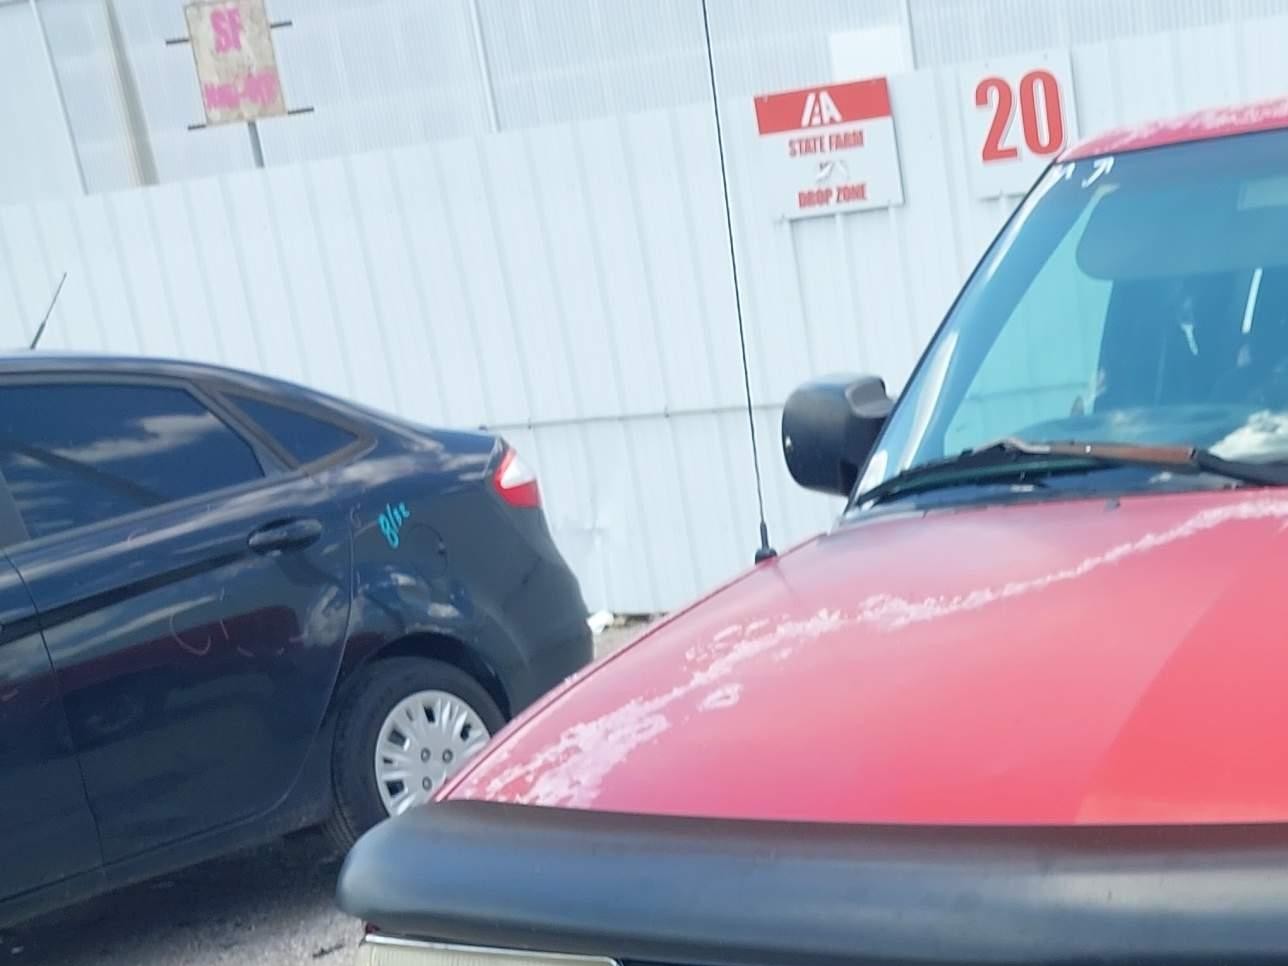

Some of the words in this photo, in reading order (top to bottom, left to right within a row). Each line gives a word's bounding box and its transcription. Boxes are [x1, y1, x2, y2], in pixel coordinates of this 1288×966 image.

[974, 68, 1065, 163] 20
[788, 134, 826, 157] STATE
[828, 129, 864, 152] FARM
[798, 187, 833, 208] DROP
[836, 183, 867, 204] ZONE
